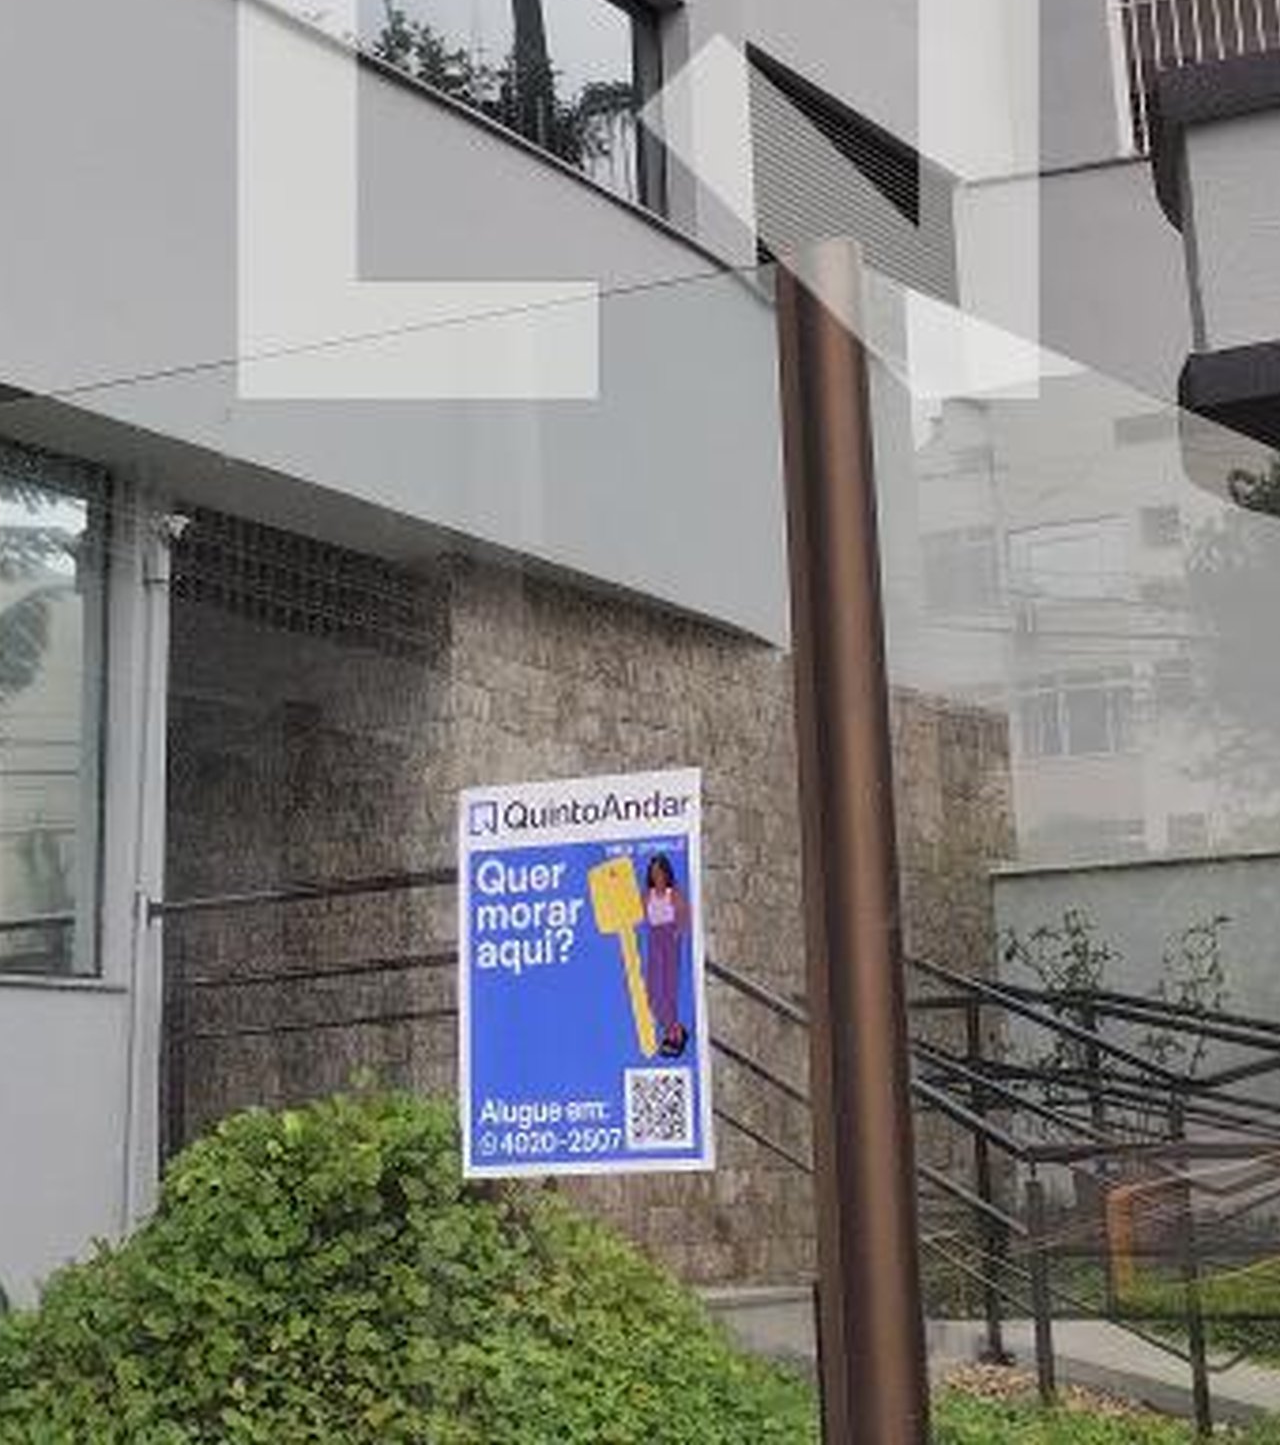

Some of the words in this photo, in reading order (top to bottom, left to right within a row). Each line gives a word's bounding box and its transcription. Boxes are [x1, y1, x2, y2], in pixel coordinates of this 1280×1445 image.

[504, 790, 690, 830] QuintoAndar
[476, 859, 566, 894] Quer
[476, 896, 584, 931] morar
[476, 927, 575, 974] aqui?
[480, 1098, 562, 1130] Alugue
